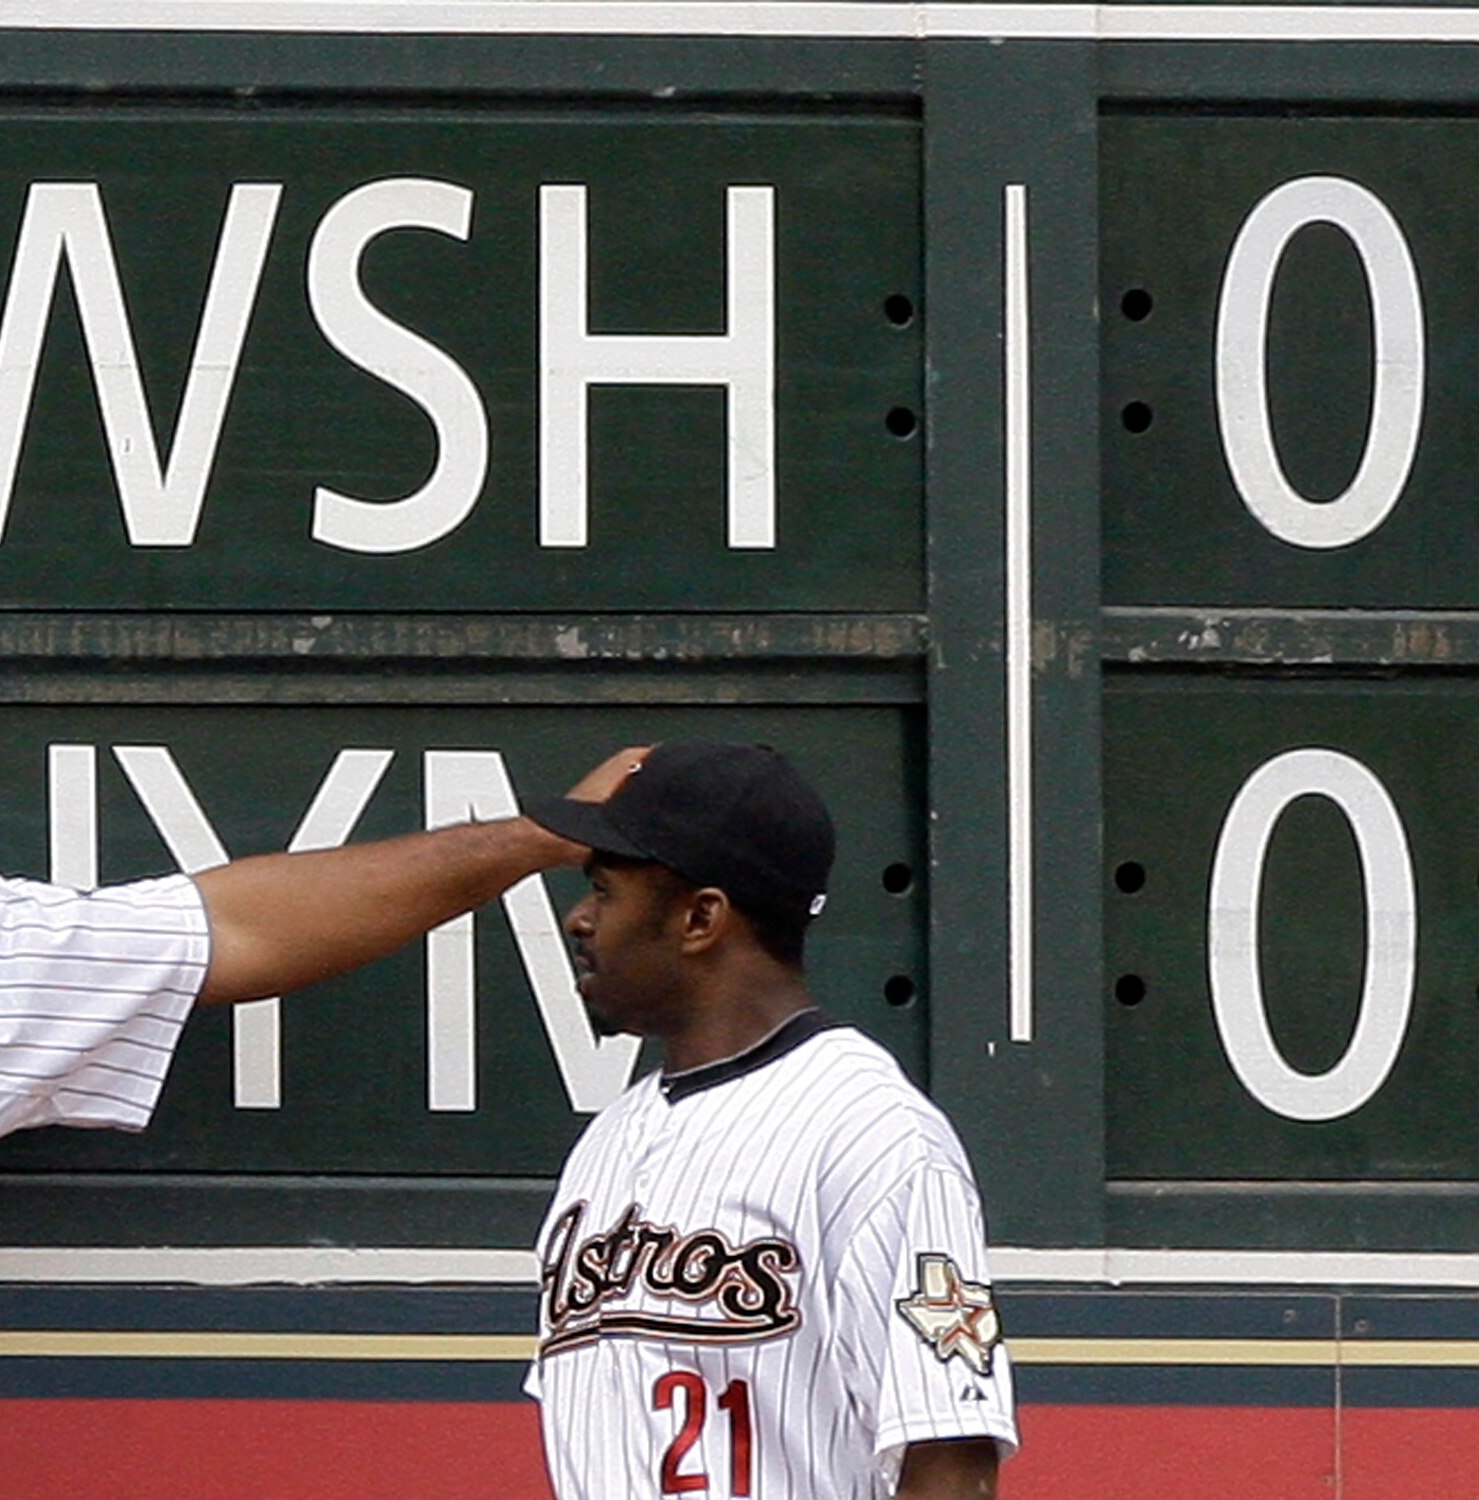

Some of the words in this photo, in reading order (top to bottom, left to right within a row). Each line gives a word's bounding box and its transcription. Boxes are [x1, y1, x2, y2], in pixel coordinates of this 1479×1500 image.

[1215, 175, 1425, 550] 0
[1207, 747, 1417, 1121] 0
[538, 1199, 804, 1357] Astros
[652, 1370, 752, 1498] 21
